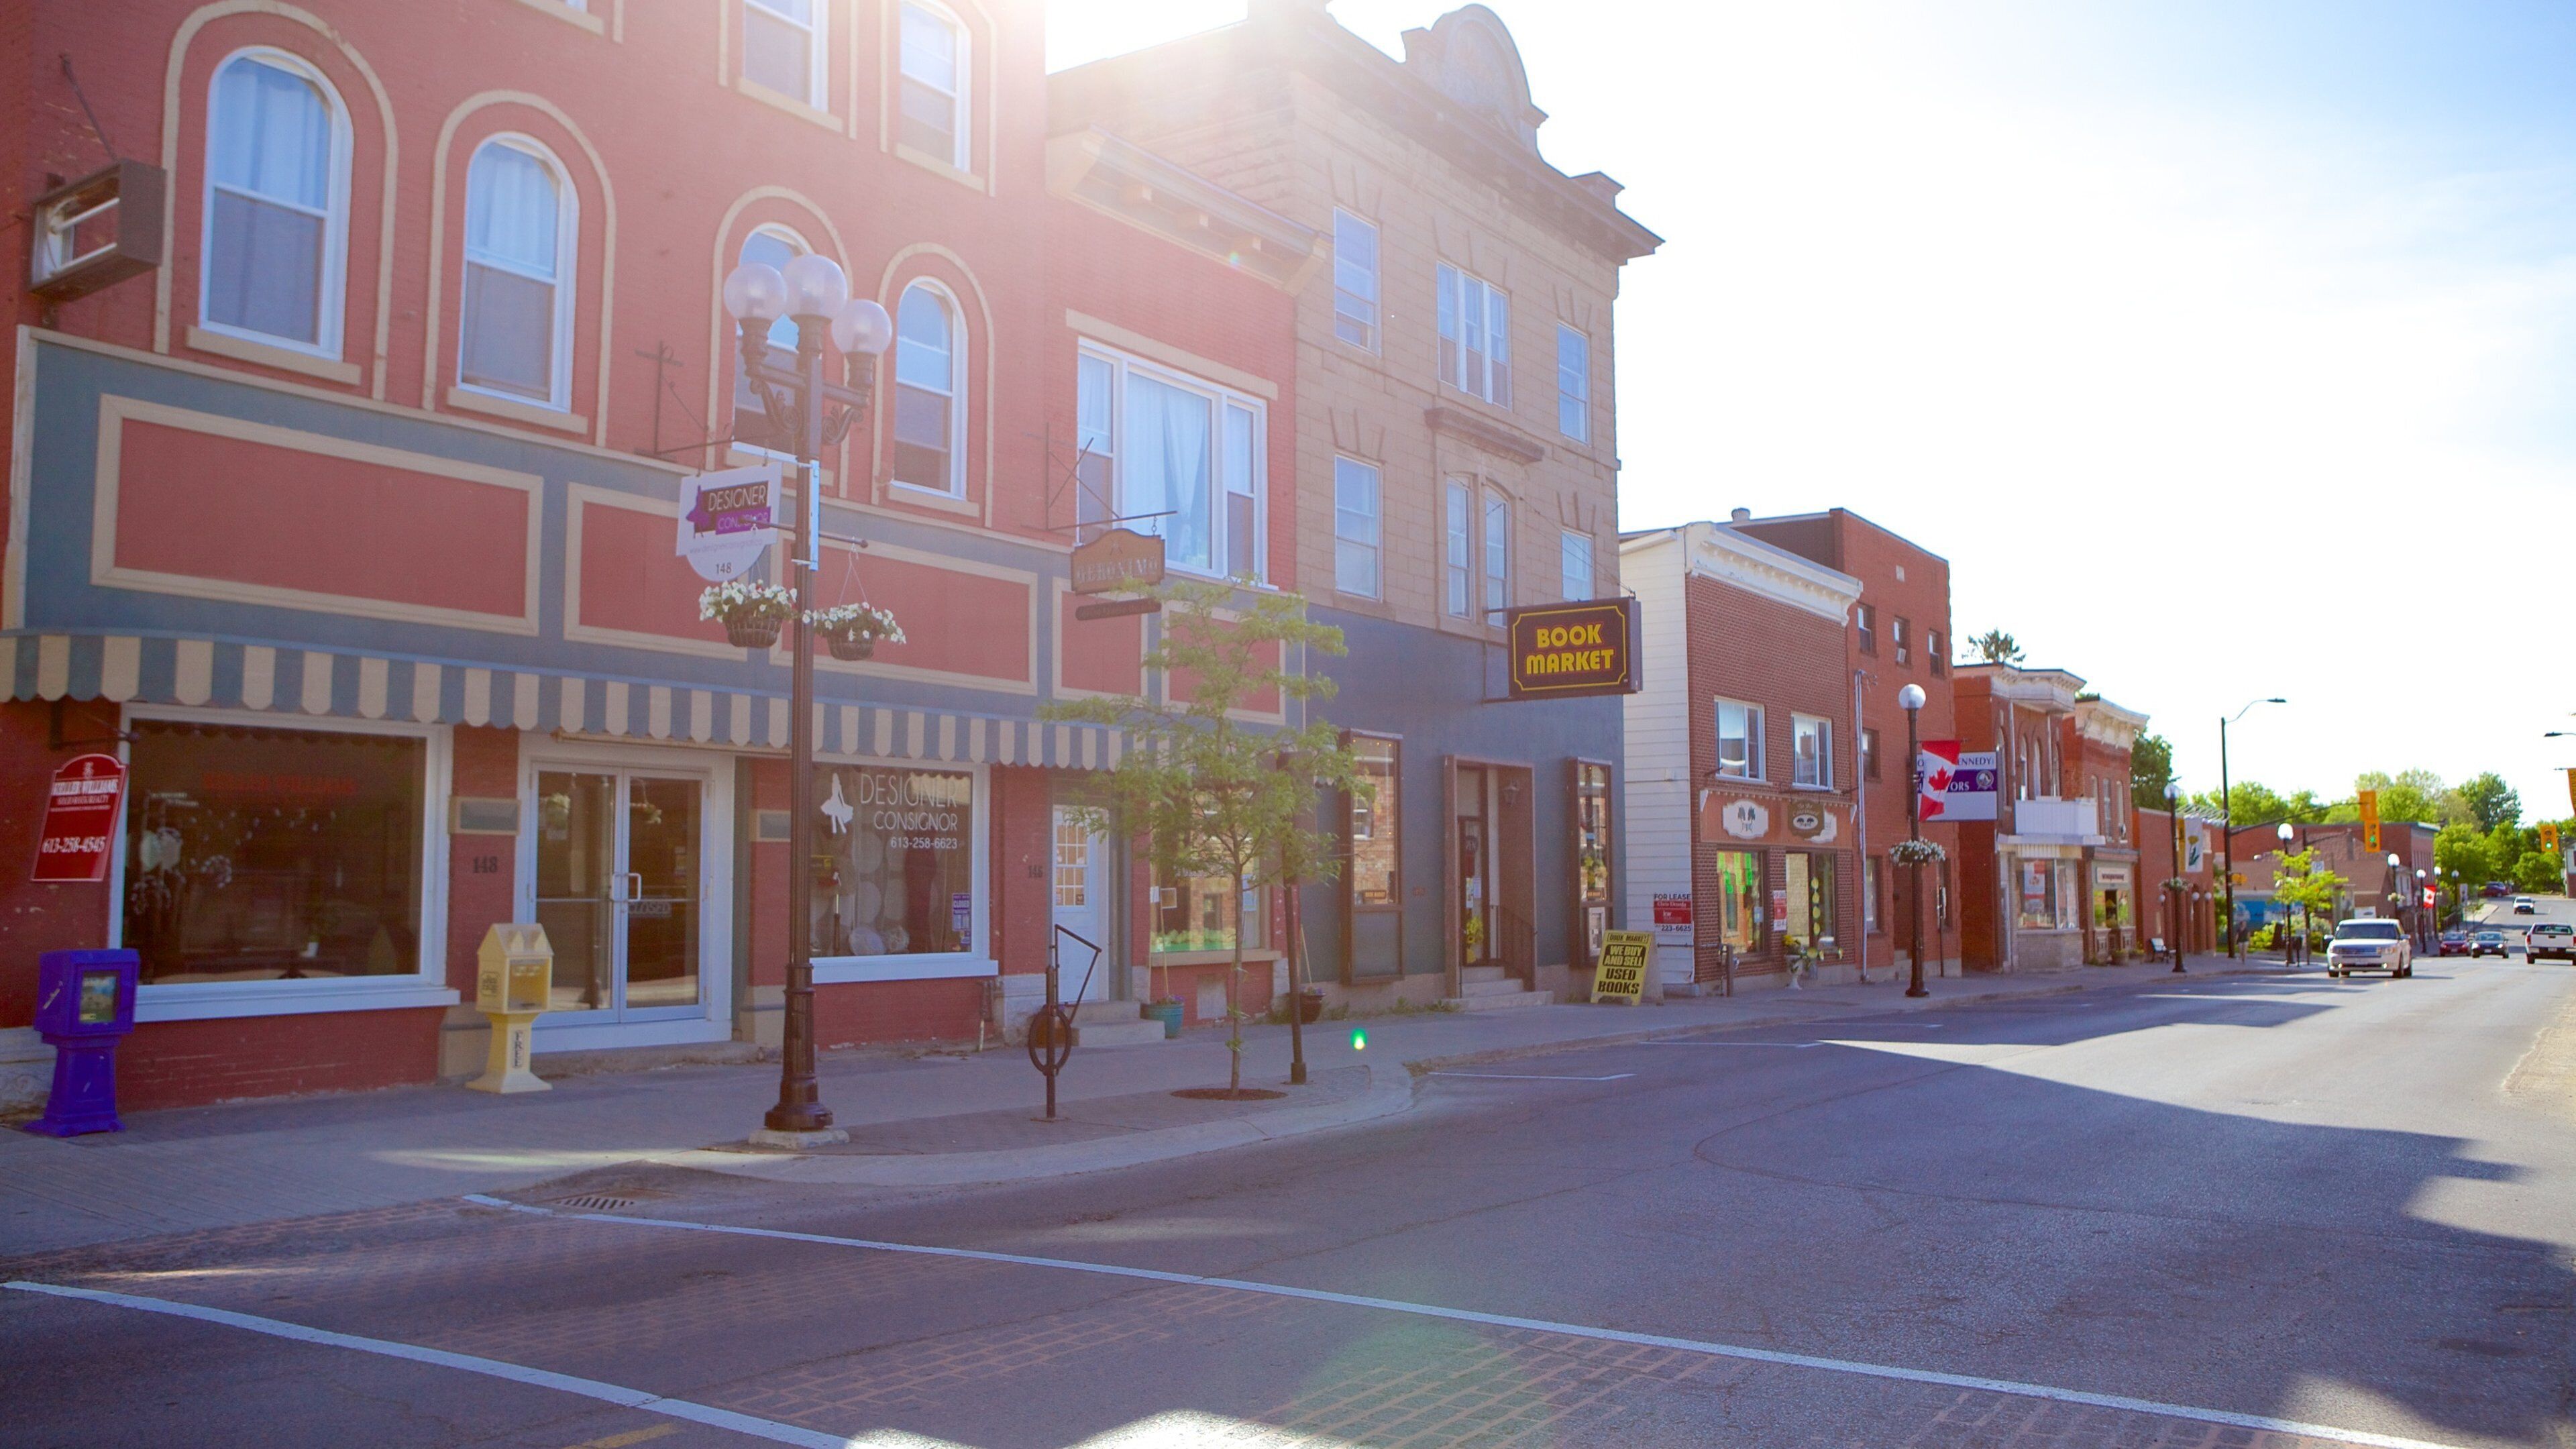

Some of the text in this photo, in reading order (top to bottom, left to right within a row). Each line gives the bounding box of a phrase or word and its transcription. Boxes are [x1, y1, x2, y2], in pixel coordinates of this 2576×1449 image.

[708, 484, 766, 512] DESIGNER
[716, 562, 732, 574] 148
[1536, 623, 1602, 648] BOOK
[1525, 649, 1615, 675] MARKET
[81, 780, 118, 795] WILLIAMS
[860, 773, 957, 808] DESIGNER
[873, 810, 958, 831] CONSIGNOR
[890, 837, 958, 850] 613-258-6623
[473, 856, 498, 873] 148
[1609, 946, 1643, 957] WE BUY
[1604, 955, 1643, 967] AND SELL
[1605, 968, 1637, 980] USED
[1597, 981, 1640, 994] BOOKS
